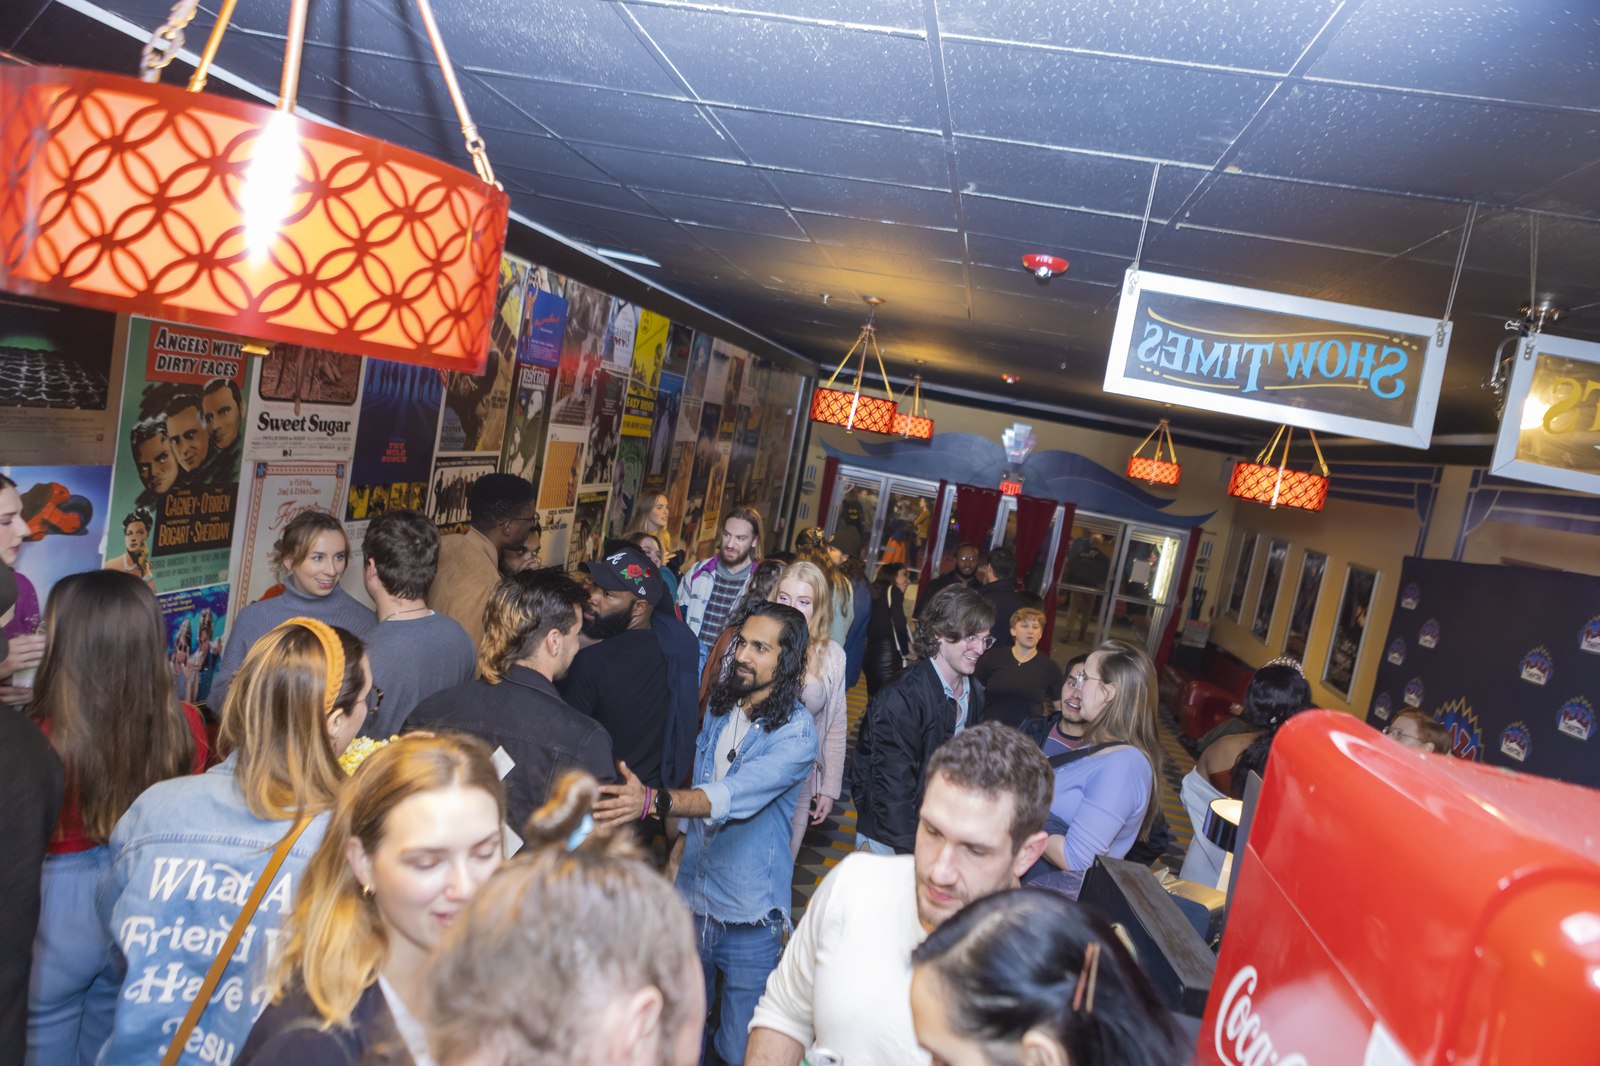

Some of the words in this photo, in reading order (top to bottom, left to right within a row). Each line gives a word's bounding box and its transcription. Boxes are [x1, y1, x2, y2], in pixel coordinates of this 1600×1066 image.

[1035, 254, 1053, 264] FIRE
[154, 327, 209, 355] ANGELS
[211, 338, 244, 359] WITH
[155, 353, 200, 374] DIRTY
[199, 359, 239, 378] FACES
[257, 412, 307, 432] Sweet
[308, 414, 351, 436] Sugar
[1004, 482, 1021, 496] EXIT
[165, 494, 197, 517] CAGNEY
[201, 492, 231, 514] O'BRIEN
[158, 524, 191, 547] BOGART
[193, 521, 230, 543] SHERIDAN
[149, 856, 254, 904] What
[258, 871, 292, 914] A
